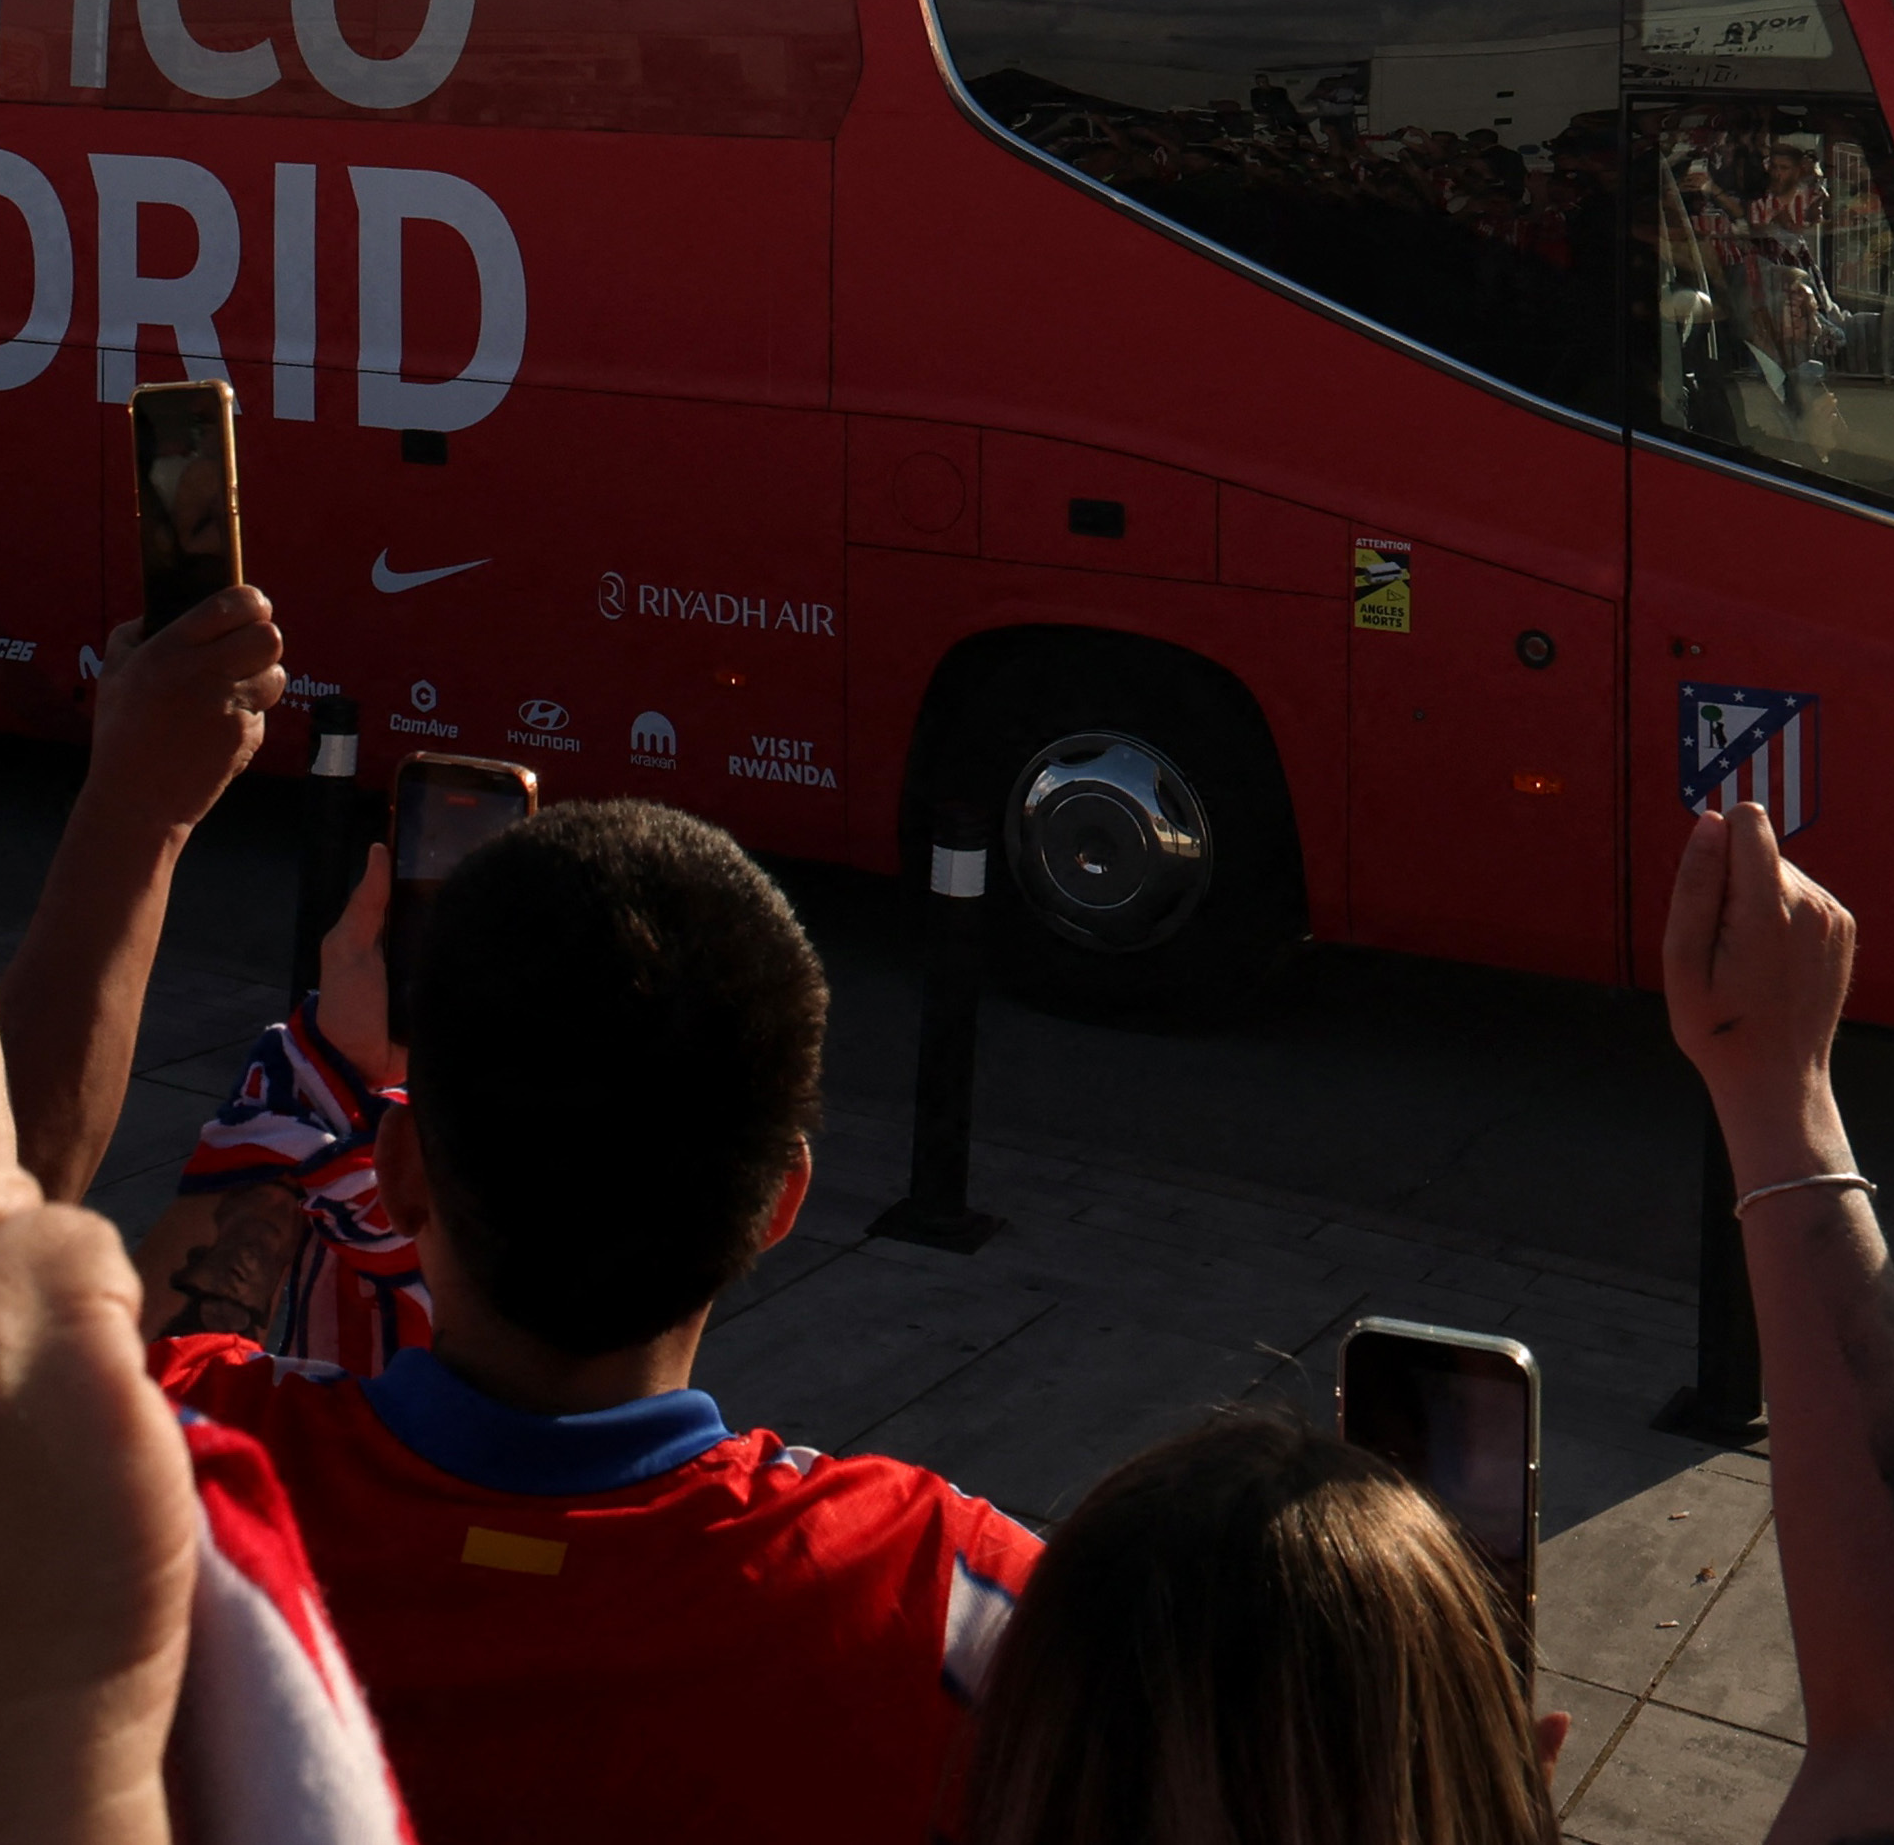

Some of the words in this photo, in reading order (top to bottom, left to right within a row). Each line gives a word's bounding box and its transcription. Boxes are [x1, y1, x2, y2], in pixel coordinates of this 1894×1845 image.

[1355, 537, 1412, 552] ATTENTION
[638, 583, 766, 629] RIYADH
[774, 600, 836, 637] AIR
[1360, 603, 1405, 618] ANGLES
[1362, 614, 1403, 628] MORTS
[389, 713, 459, 739] ComAve
[507, 729, 581, 753] HYUNDAI
[751, 735, 815, 762] VISIT
[630, 754, 677, 771] kraken
[728, 755, 838, 789] RWANDA
